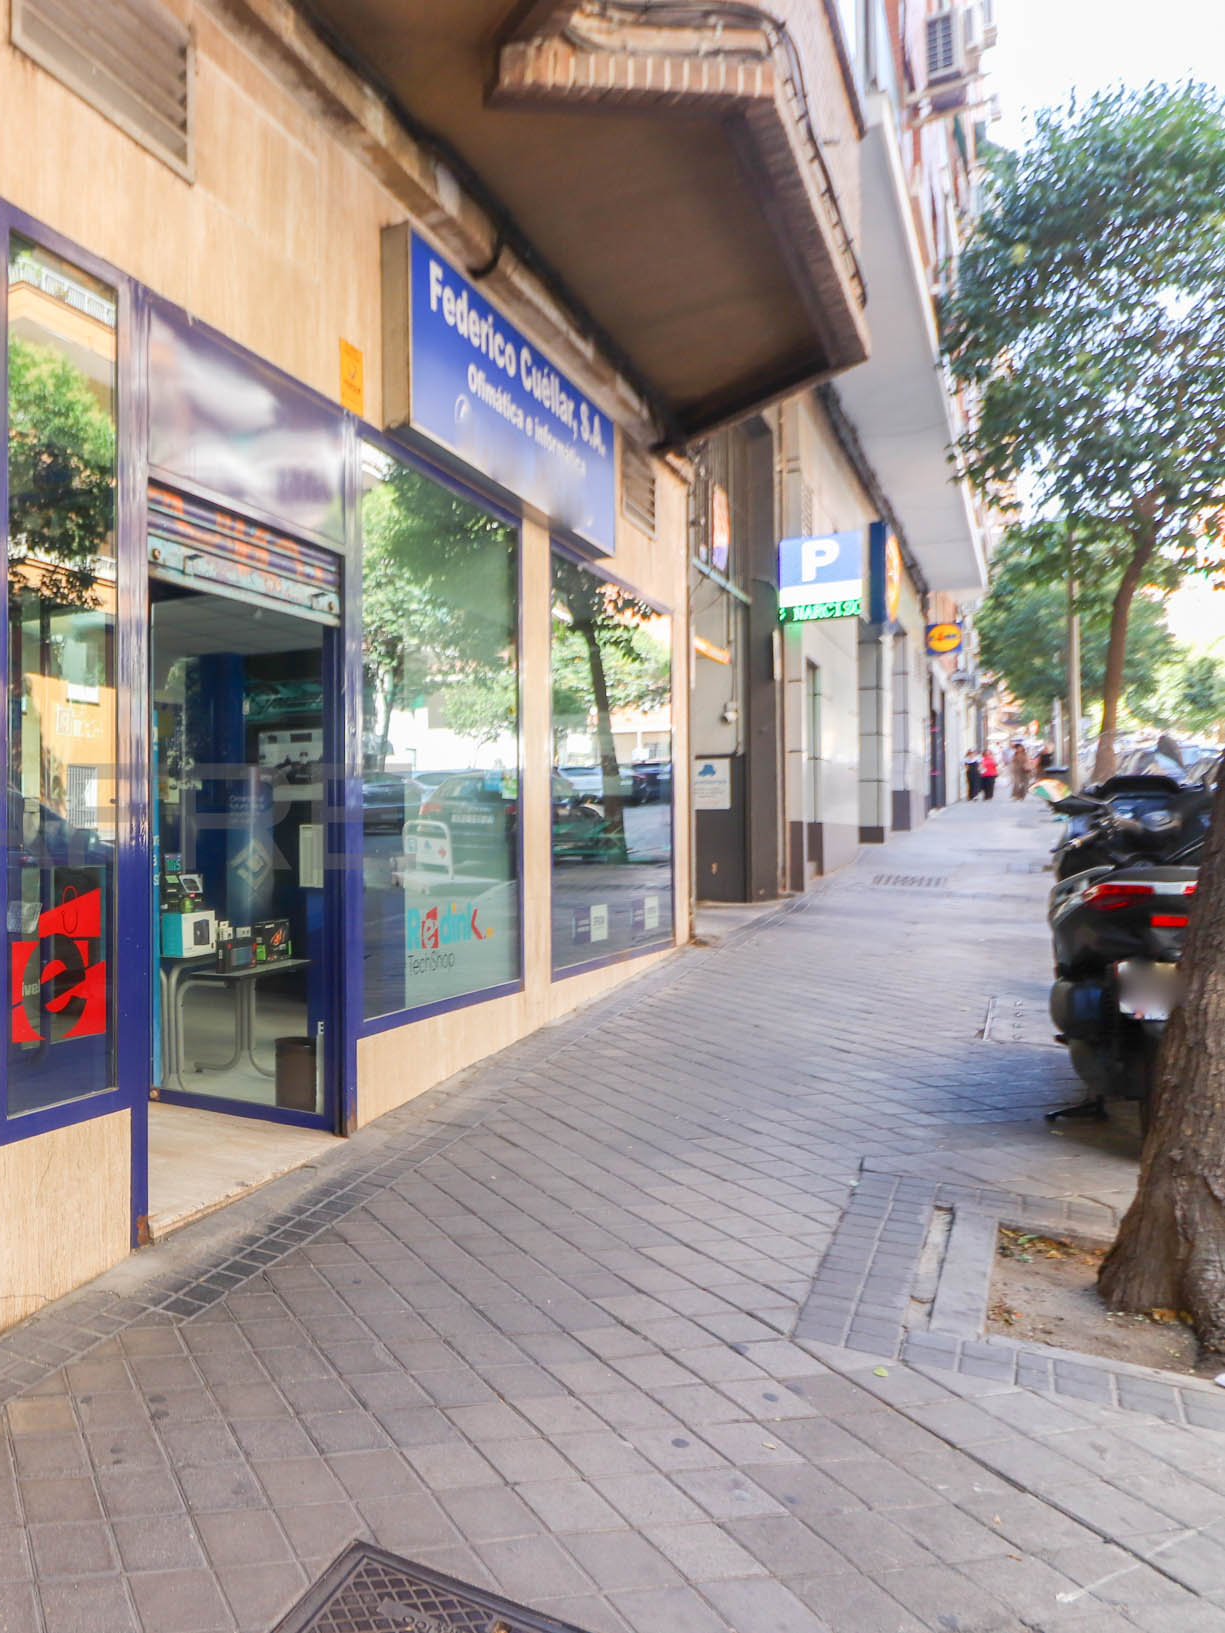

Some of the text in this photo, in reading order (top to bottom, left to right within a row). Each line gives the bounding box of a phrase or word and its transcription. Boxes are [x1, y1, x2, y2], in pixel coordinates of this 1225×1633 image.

[429, 258, 517, 378] Federico
[520, 346, 578, 441] Cuéllar,
[580, 401, 607, 457] S.A.
[467, 363, 525, 430] Ofimática
[526, 415, 534, 437] e
[801, 538, 840, 583] P
